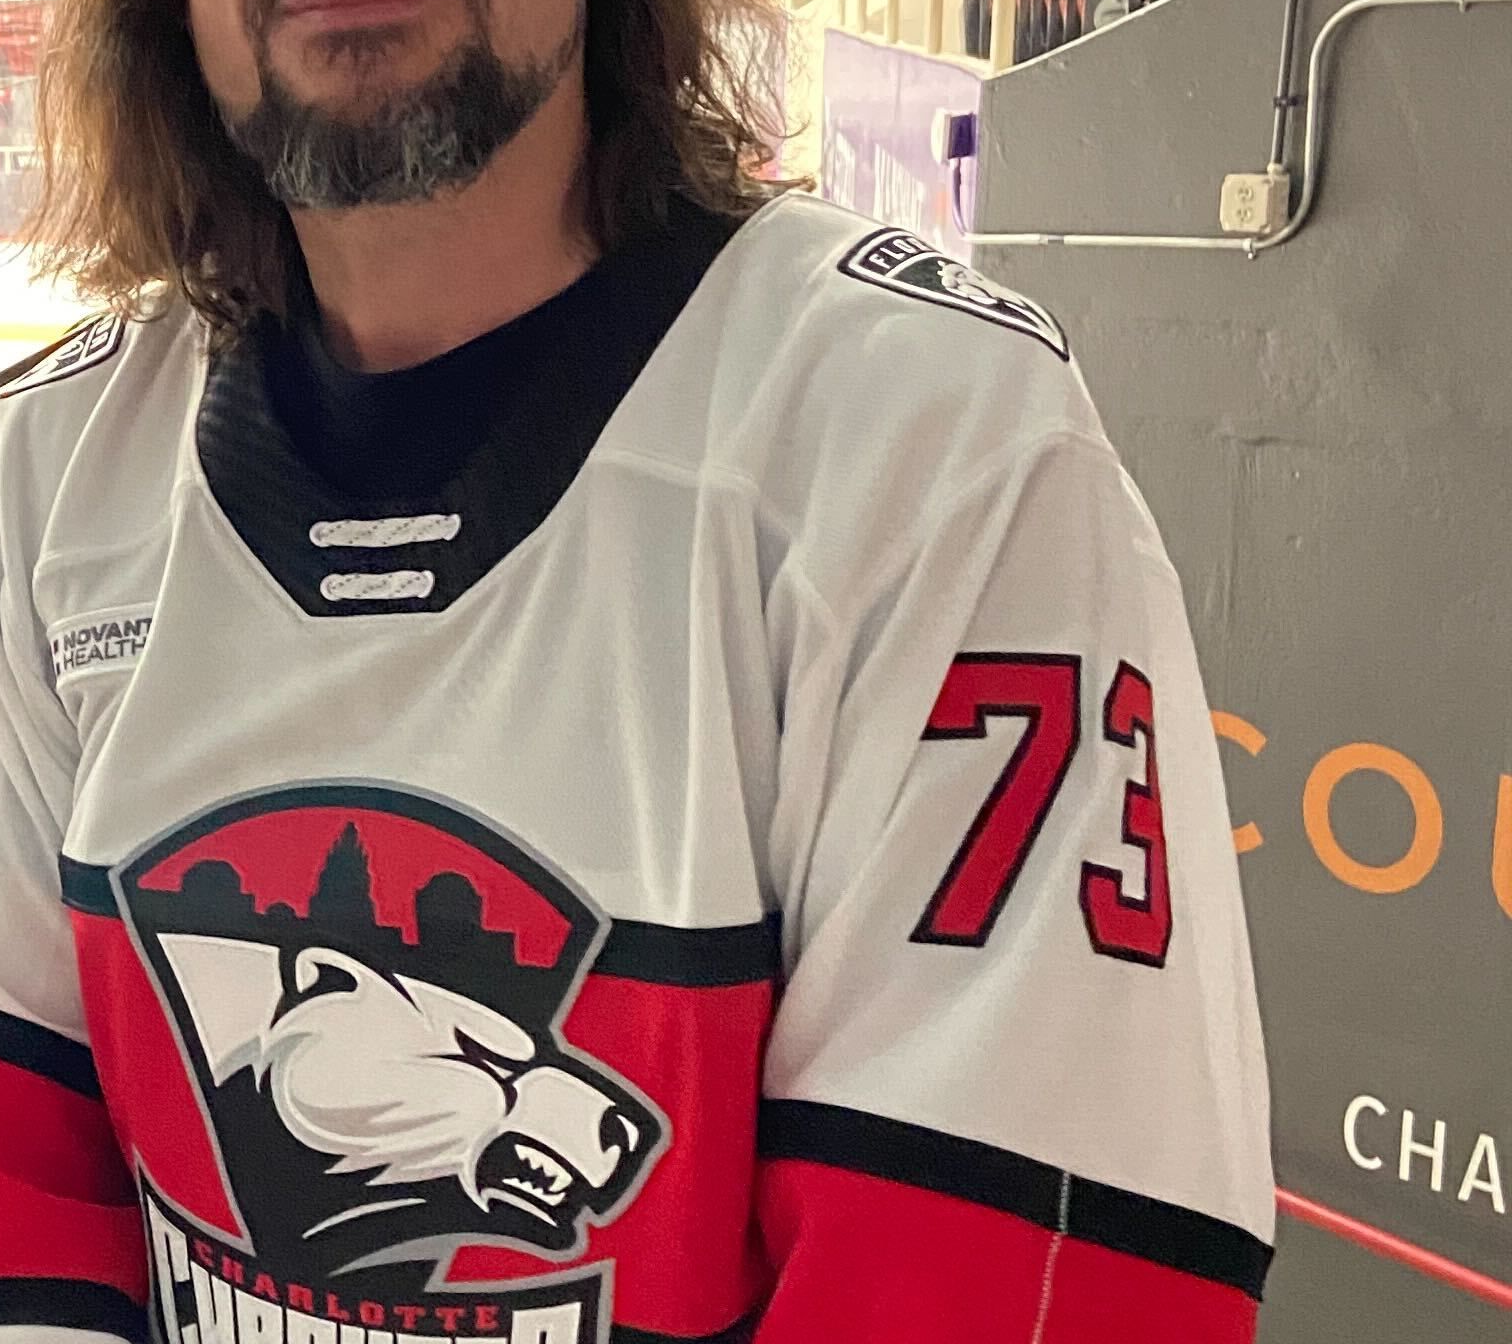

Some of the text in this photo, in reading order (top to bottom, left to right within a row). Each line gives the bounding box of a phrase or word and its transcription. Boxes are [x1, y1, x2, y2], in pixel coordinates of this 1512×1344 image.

[64, 617, 153, 652] NOVANT
[64, 636, 147, 671] HEALTH
[908, 651, 1174, 970] 73
[1343, 1094, 1506, 1214] CHA
[193, 1240, 500, 1332] CHARLOTTE
